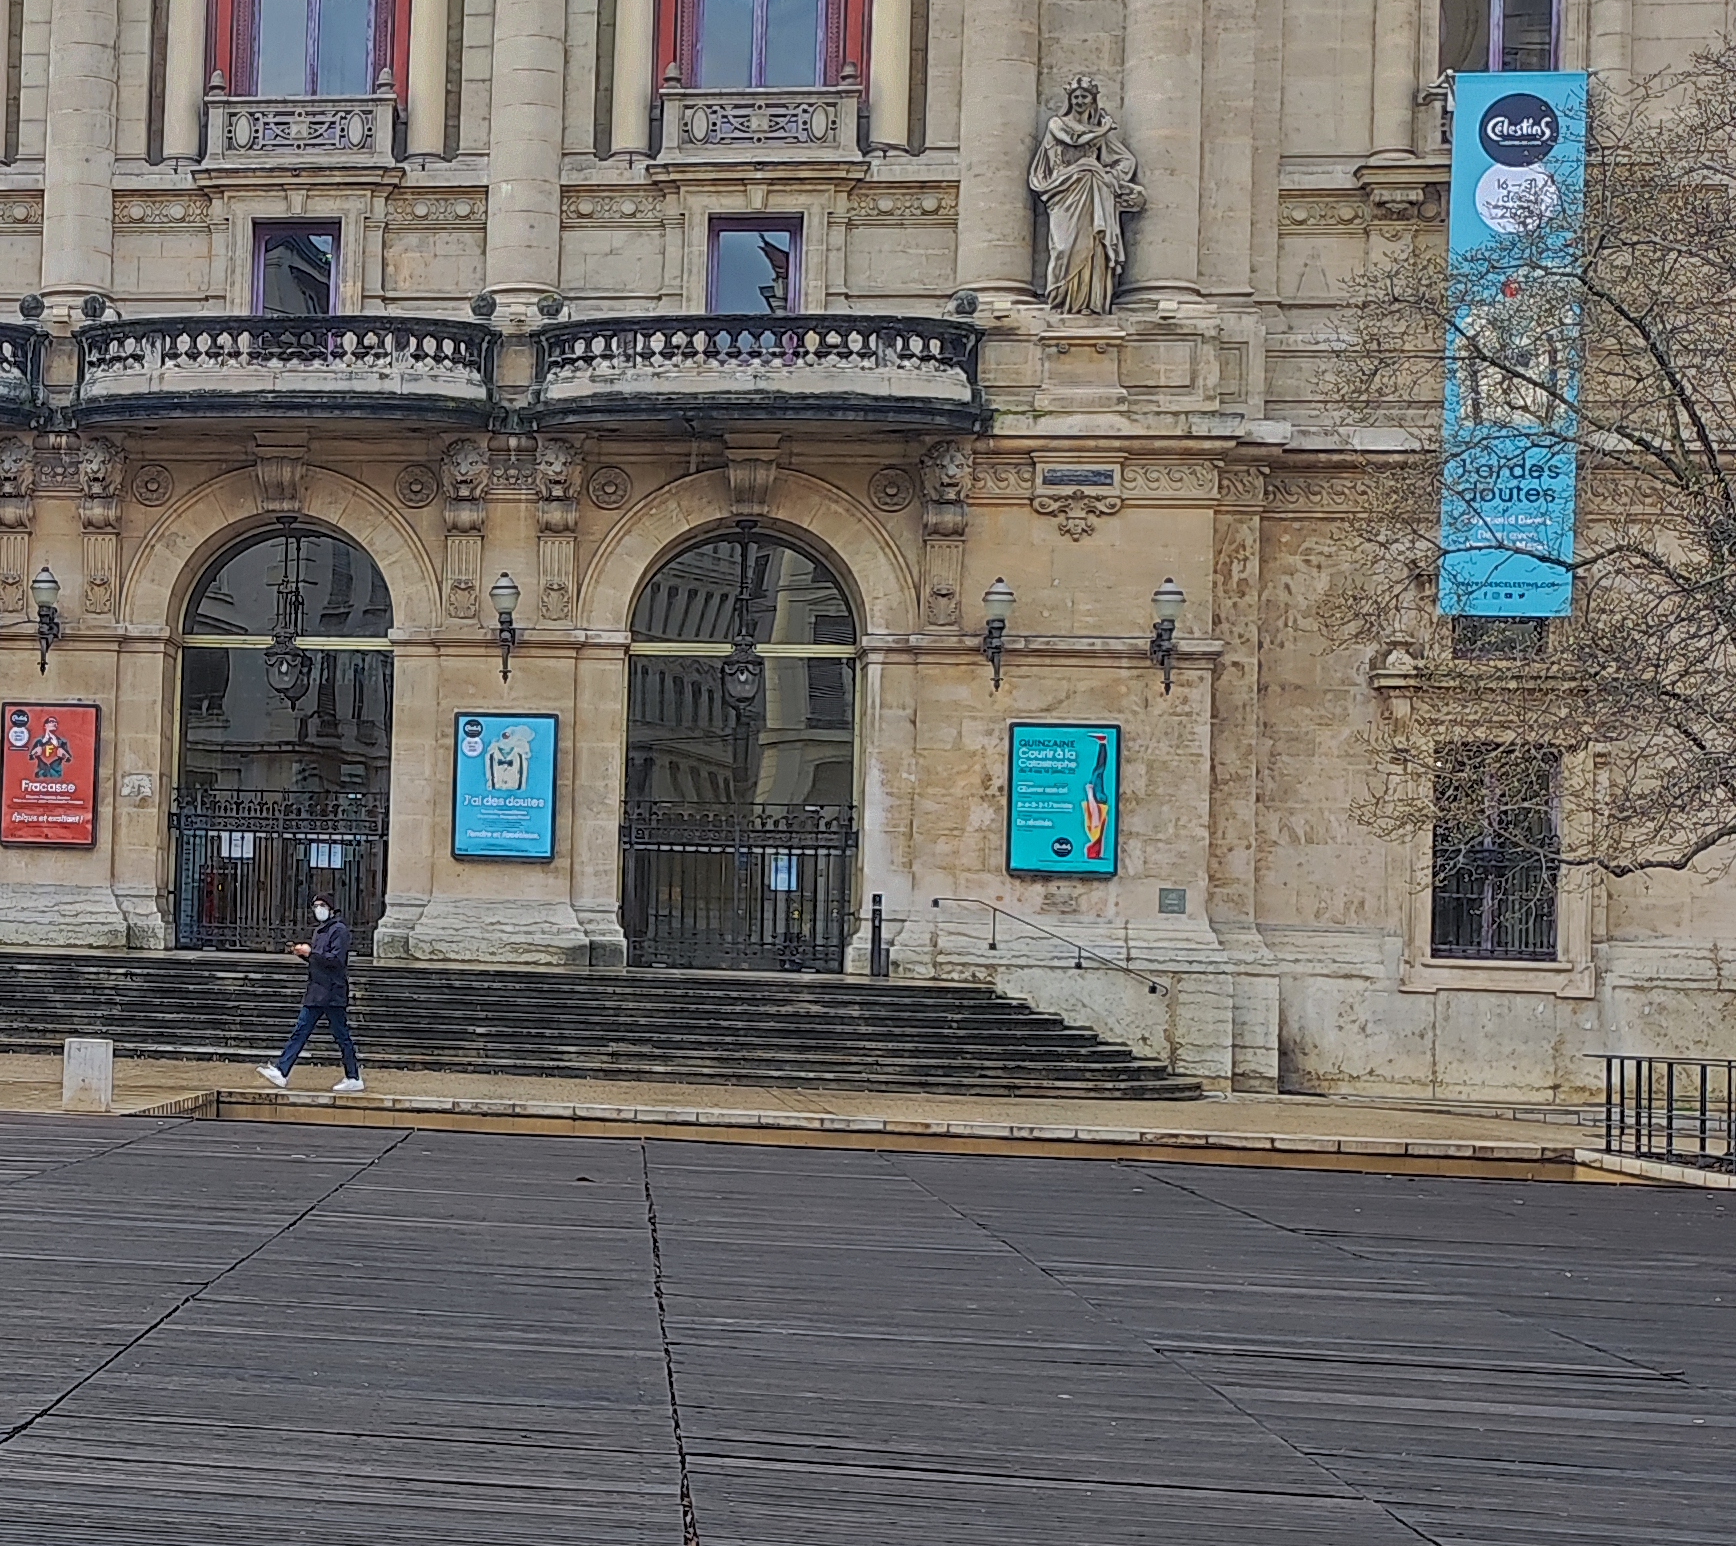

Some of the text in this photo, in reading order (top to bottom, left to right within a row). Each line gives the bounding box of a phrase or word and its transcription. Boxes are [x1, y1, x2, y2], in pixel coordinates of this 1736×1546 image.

[1019, 738, 1076, 748] QUINZAINE
[45, 745, 55, 757] F
[1018, 747, 1053, 758] Courir
[1064, 748, 1076, 759] la
[1018, 758, 1077, 769] Catastrophe
[21, 779, 76, 793] Fracasse
[463, 794, 545, 808] J'ai des doutes
